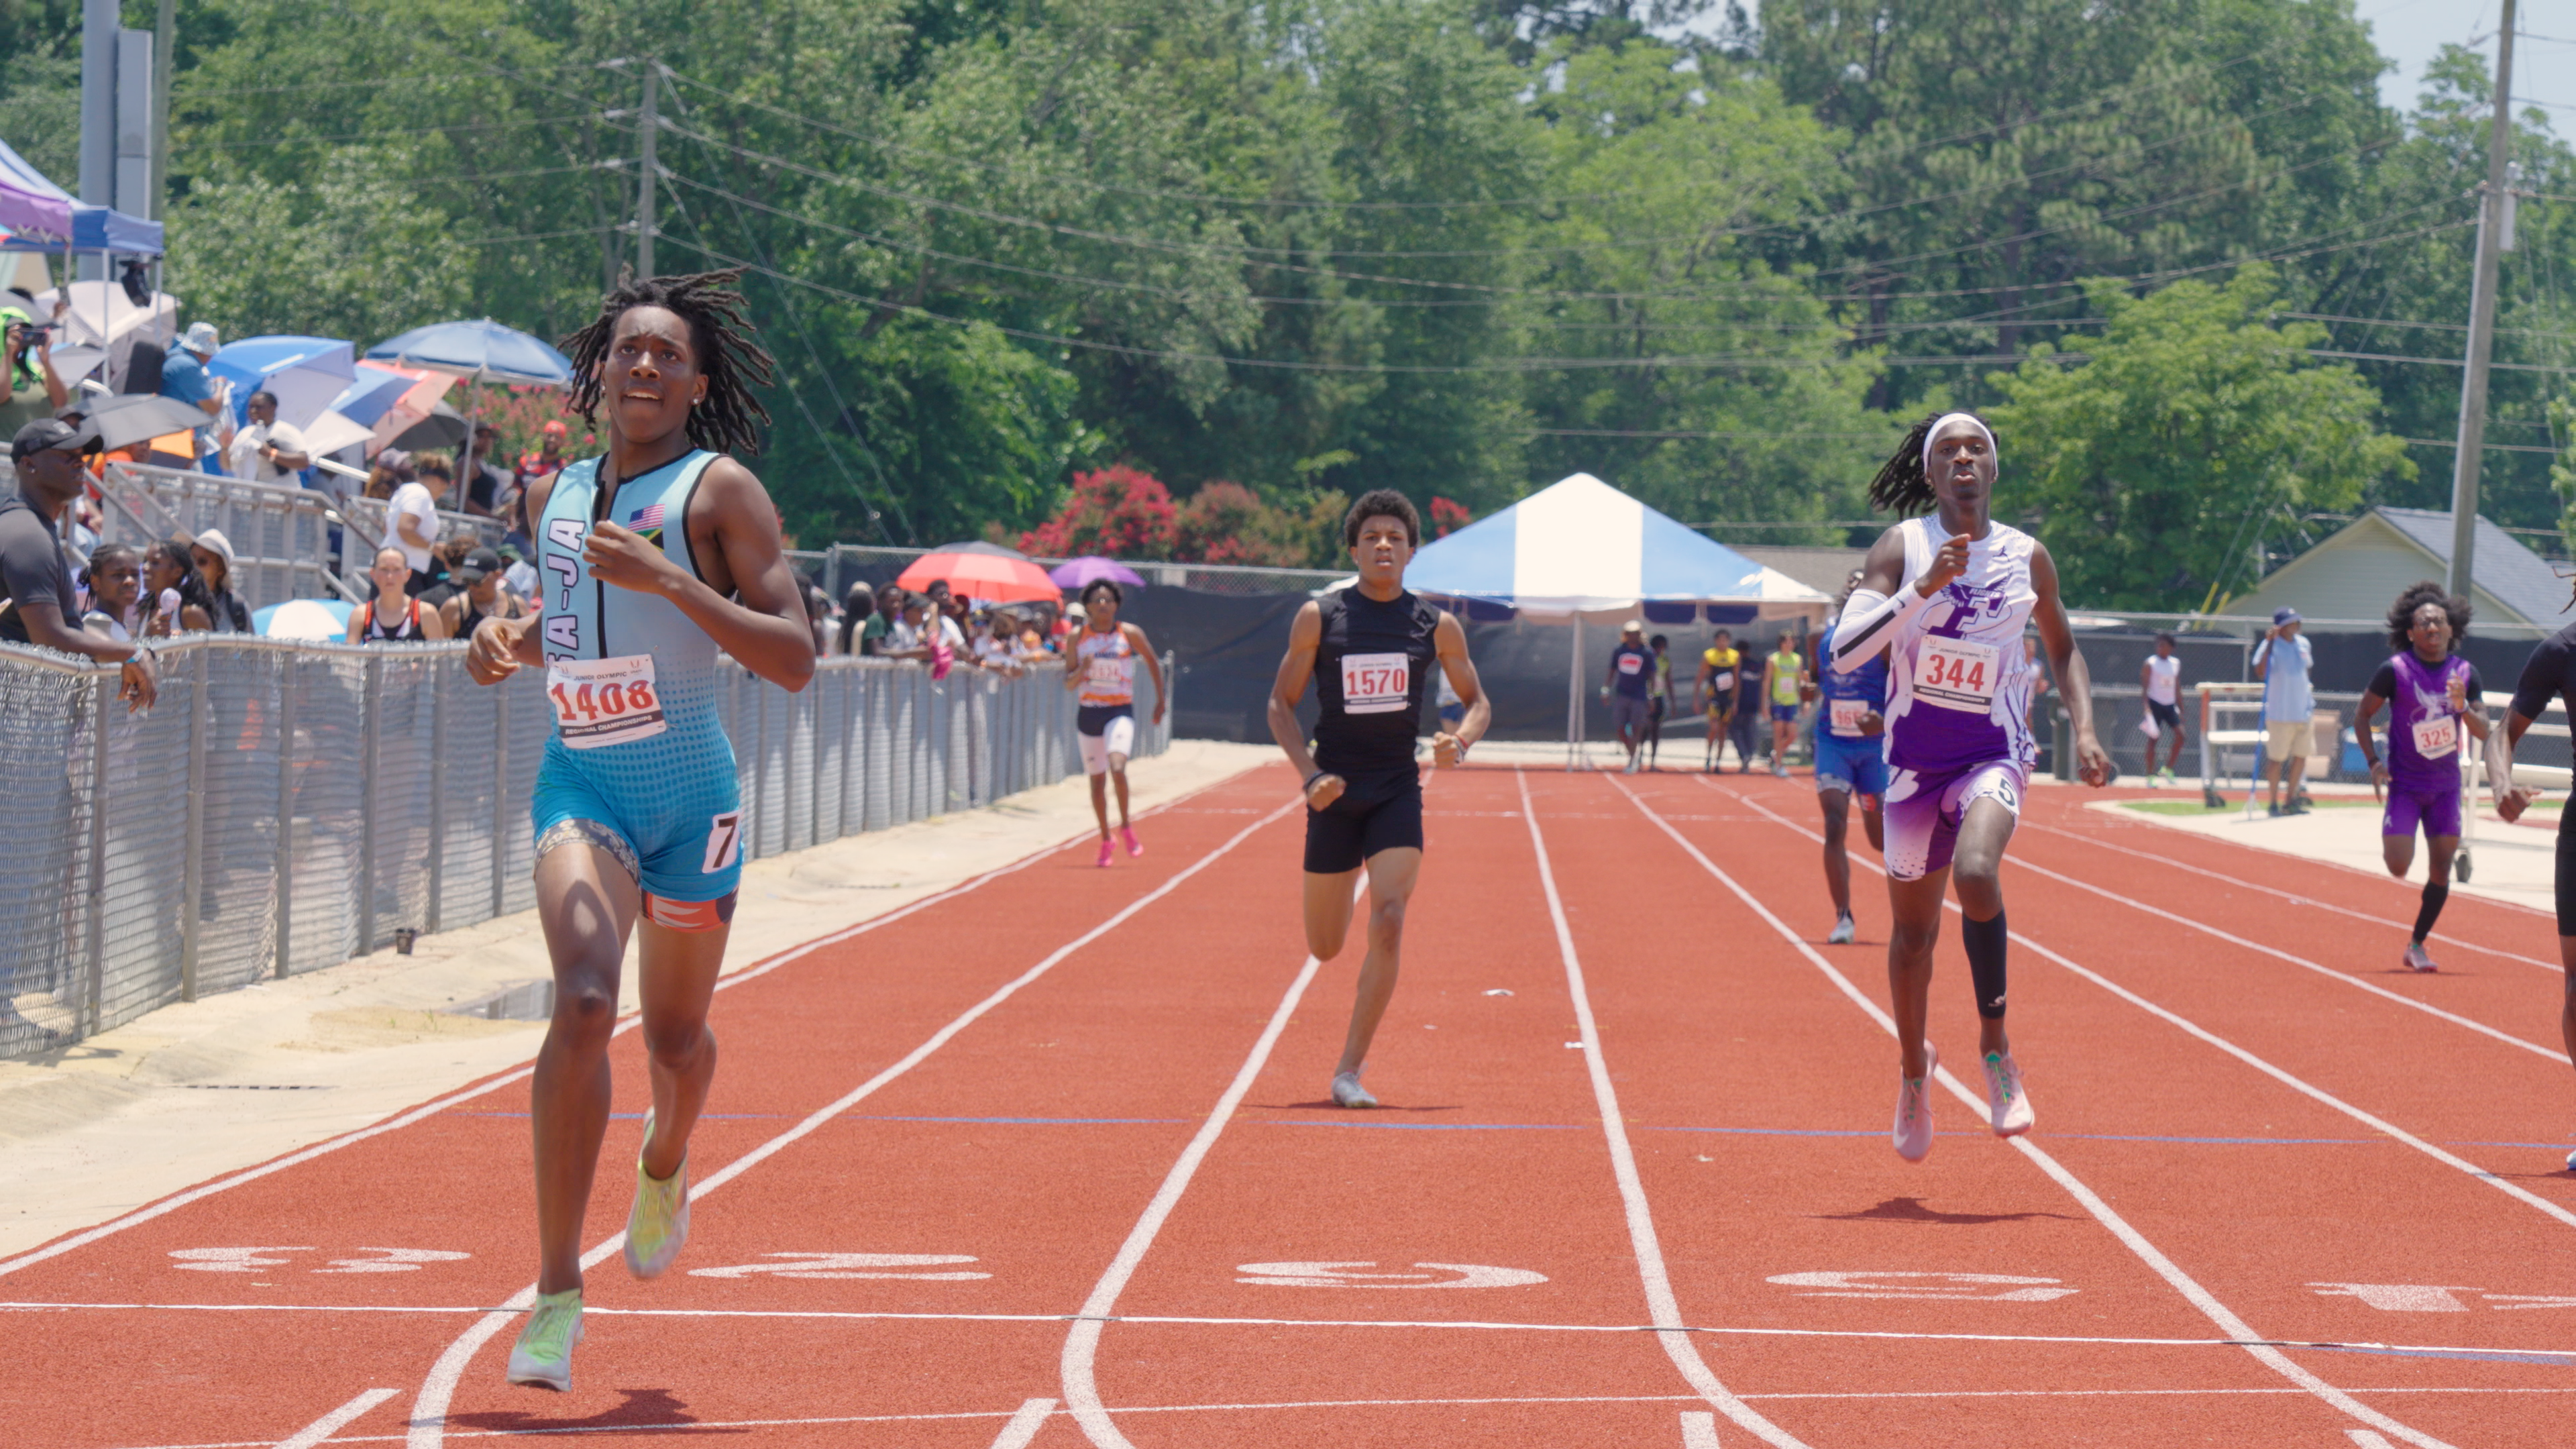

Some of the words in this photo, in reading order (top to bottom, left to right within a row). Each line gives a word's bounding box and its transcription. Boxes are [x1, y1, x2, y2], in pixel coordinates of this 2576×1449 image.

[596, 672, 627, 680] OLYMPIC
[1347, 669, 1405, 695] 1570
[1927, 654, 1984, 692] 344
[551, 680, 653, 720] 1408
[565, 727, 597, 735] REGIONAL
[598, 715, 653, 731] CHAMPIONSHIPS
[2420, 727, 2451, 748] 325
[1998, 778, 2015, 806] 5
[712, 815, 738, 868] 7
